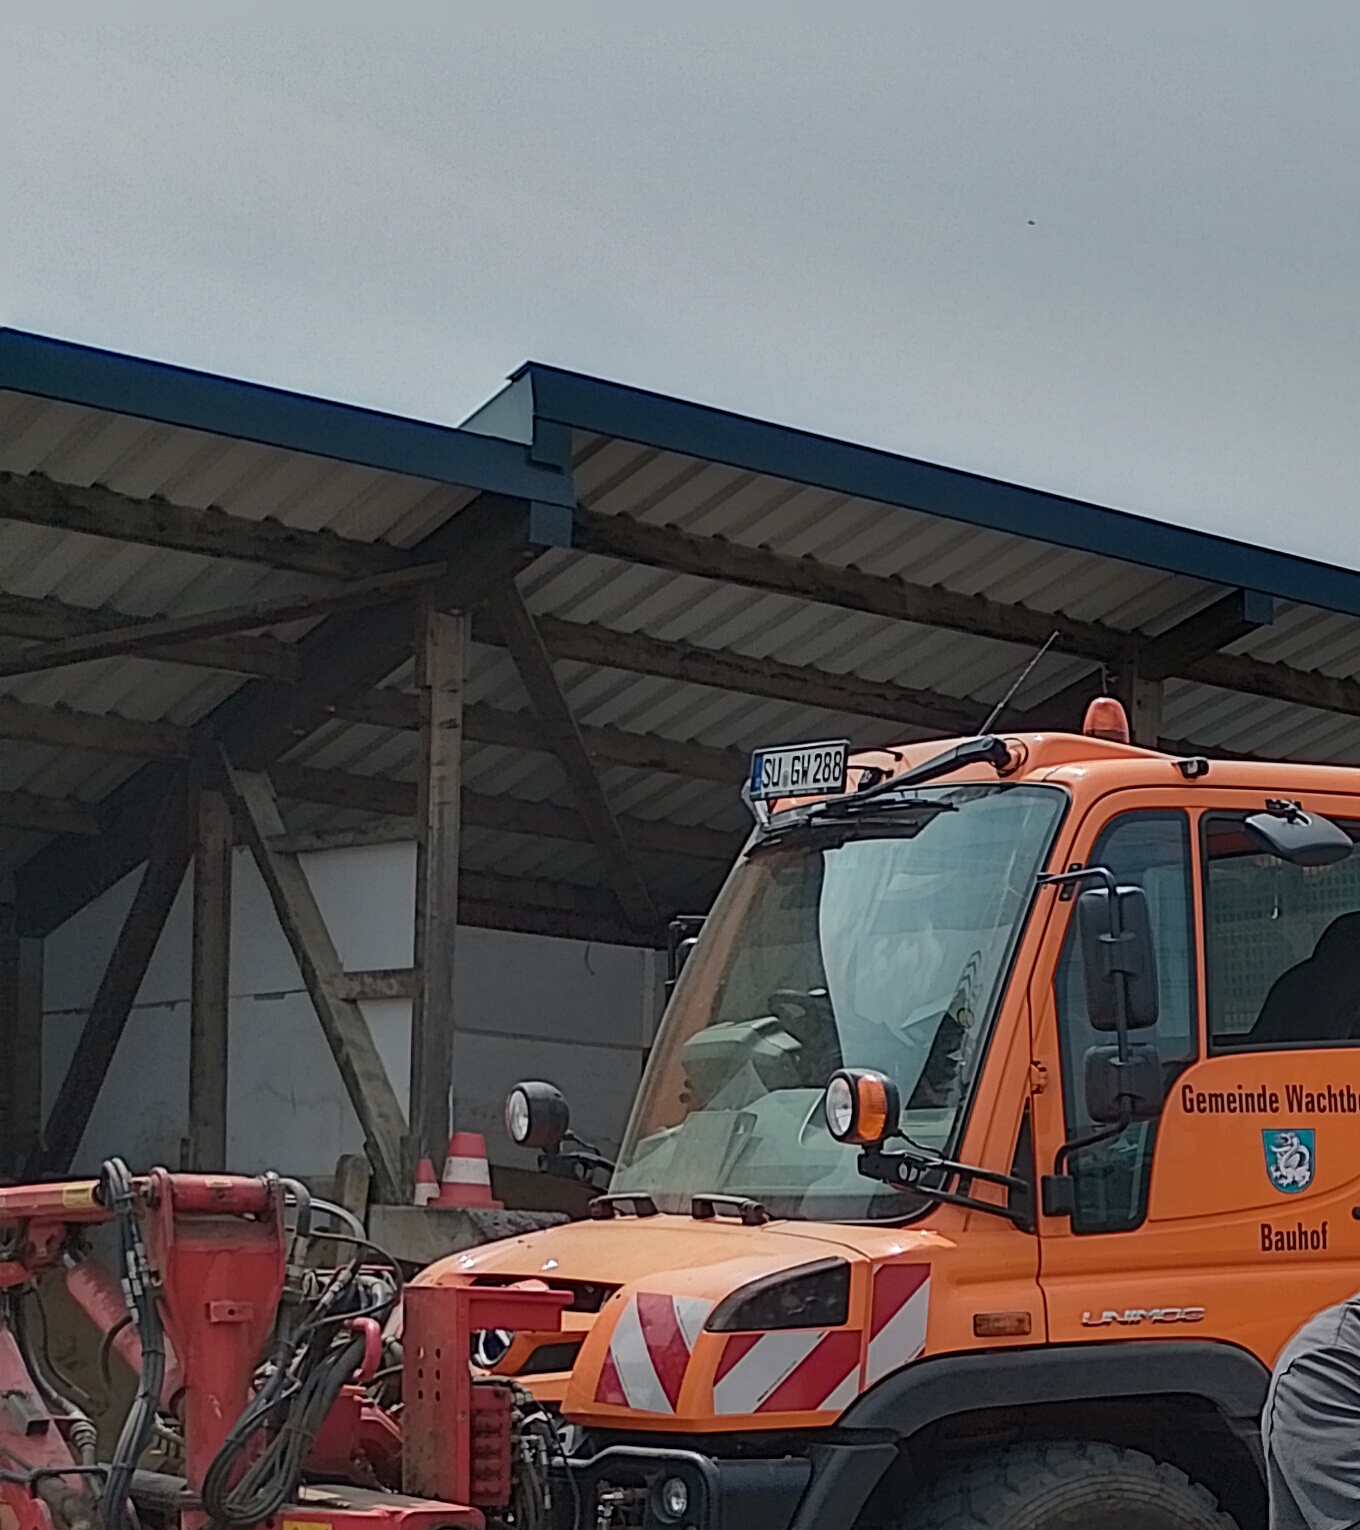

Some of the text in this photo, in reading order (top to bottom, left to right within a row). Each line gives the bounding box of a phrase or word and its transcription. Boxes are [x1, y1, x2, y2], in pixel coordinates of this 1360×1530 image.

[762, 751, 843, 788] SU GW 288
[1181, 1084, 1280, 1114] Gemeinde
[1260, 1221, 1328, 1252] Bauhof
[1081, 1306, 1206, 1328] UNIMOG
